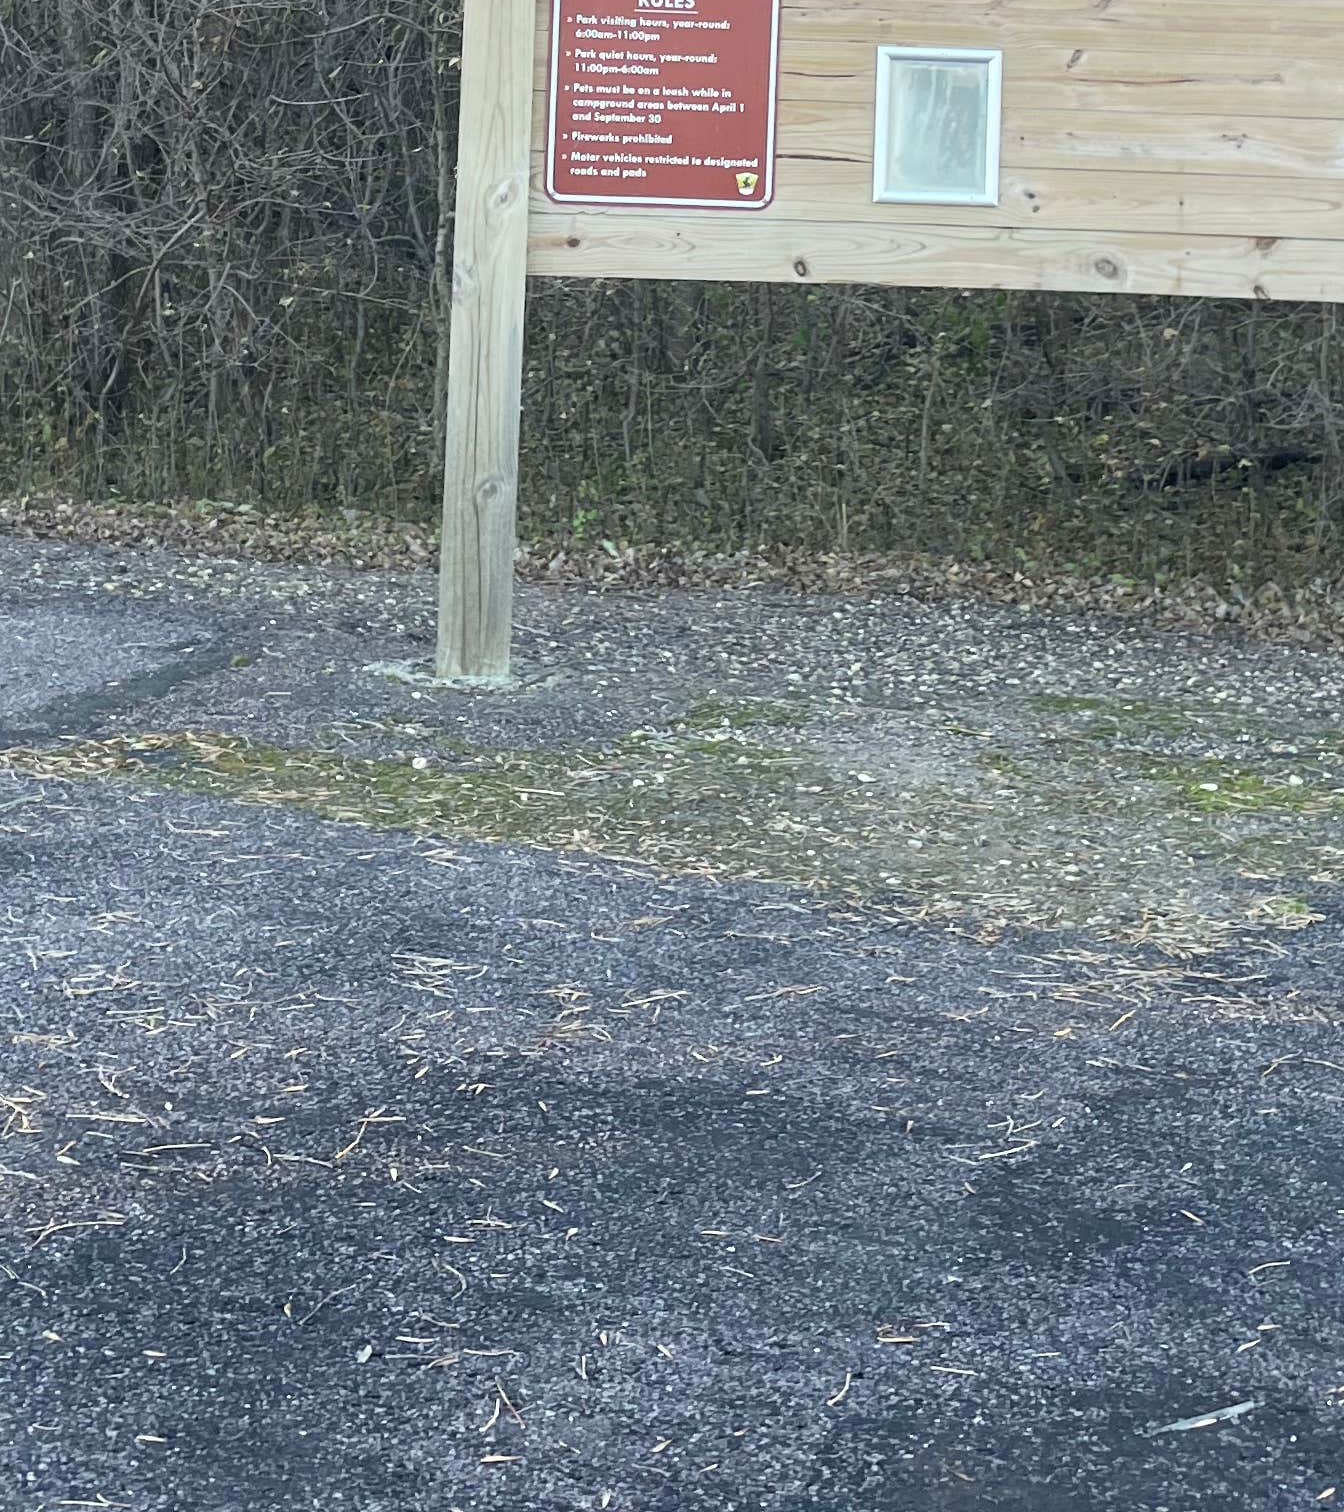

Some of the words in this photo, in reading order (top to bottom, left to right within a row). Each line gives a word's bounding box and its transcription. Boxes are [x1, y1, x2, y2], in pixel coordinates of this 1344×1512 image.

[576, 15, 597, 25] Park
[601, 17, 636, 28] visiting
[639, 18, 669, 28] hours,
[673, 20, 730, 30] year-round:
[575, 29, 660, 41] 6:00am-11:00pm
[575, 49, 596, 59] Park
[599, 51, 624, 61] quiet
[627, 52, 656, 62] hours,
[660, 54, 718, 64] year-round:
[575, 64, 659, 75] 11:00pm-6:00am
[573, 83, 593, 93] Pets
[597, 84, 620, 94] must
[623, 84, 635, 94] be
[663, 86, 688, 96] leash
[692, 87, 719, 97] while
[721, 89, 731, 97] in
[573, 99, 635, 110] campground
[637, 101, 664, 110] areas
[667, 102, 709, 112] between
[712, 103, 736, 113] April
[572, 112, 591, 121] and
[594, 113, 645, 124] September
[649, 114, 661, 124] 30
[572, 132, 620, 143] Fireworks
[623, 134, 673, 145] prohibited
[571, 152, 600, 163] Motor
[603, 154, 642, 163] vehicles
[645, 156, 689, 165] restricted
[692, 157, 702, 166] to
[704, 158, 758, 168] designated
[570, 166, 598, 176] roads
[601, 167, 620, 177] and
[623, 168, 646, 178] pads
